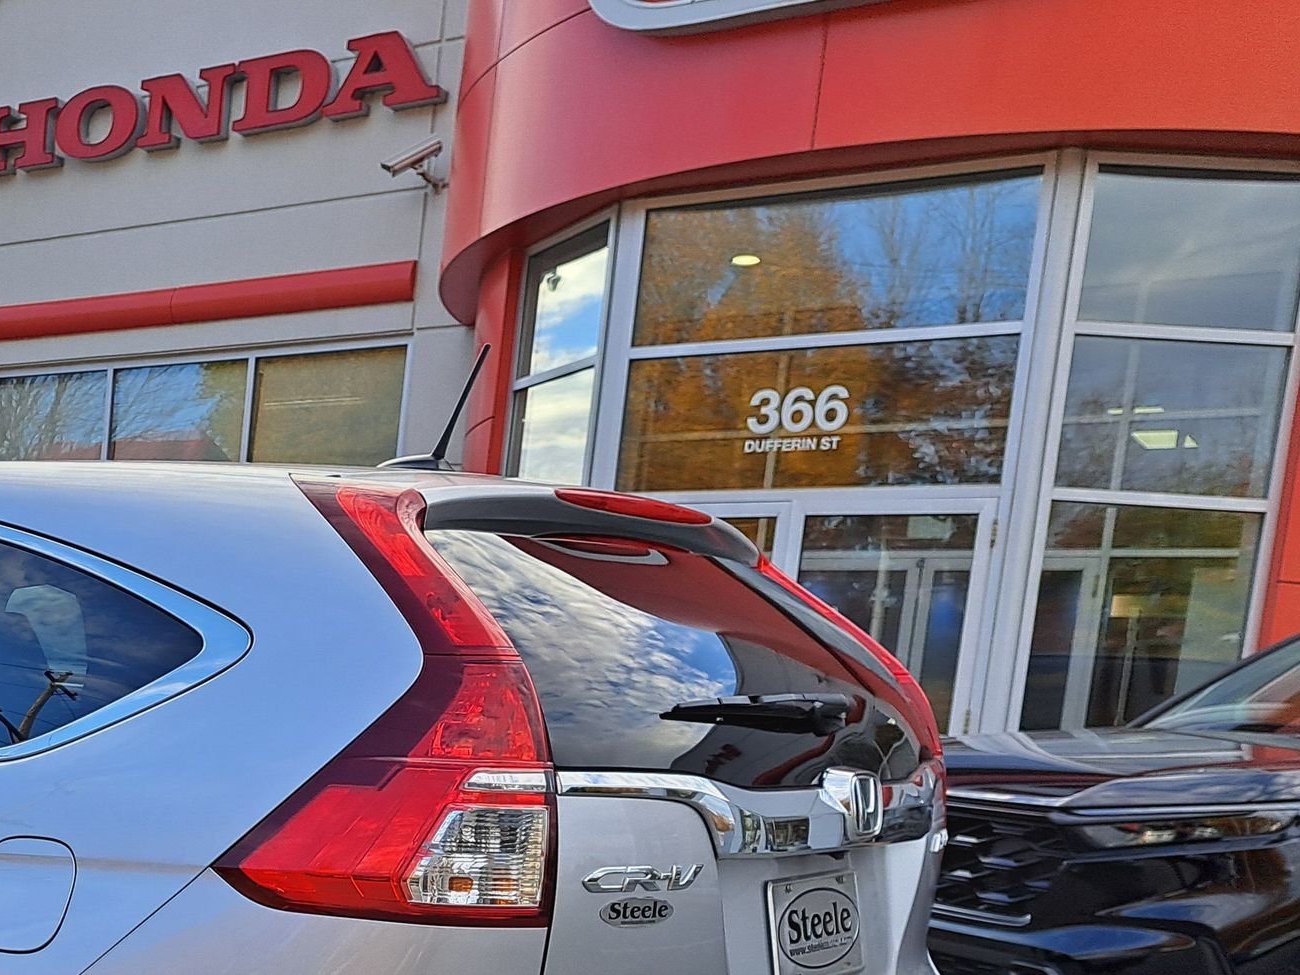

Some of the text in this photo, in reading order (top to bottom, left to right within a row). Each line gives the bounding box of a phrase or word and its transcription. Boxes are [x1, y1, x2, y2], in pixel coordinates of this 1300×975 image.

[746, 384, 850, 434] 366
[743, 435, 841, 453] DUFFERIN ST
[582, 864, 704, 893] CR-V
[608, 901, 669, 921] Steele
[787, 901, 852, 945] Steele
